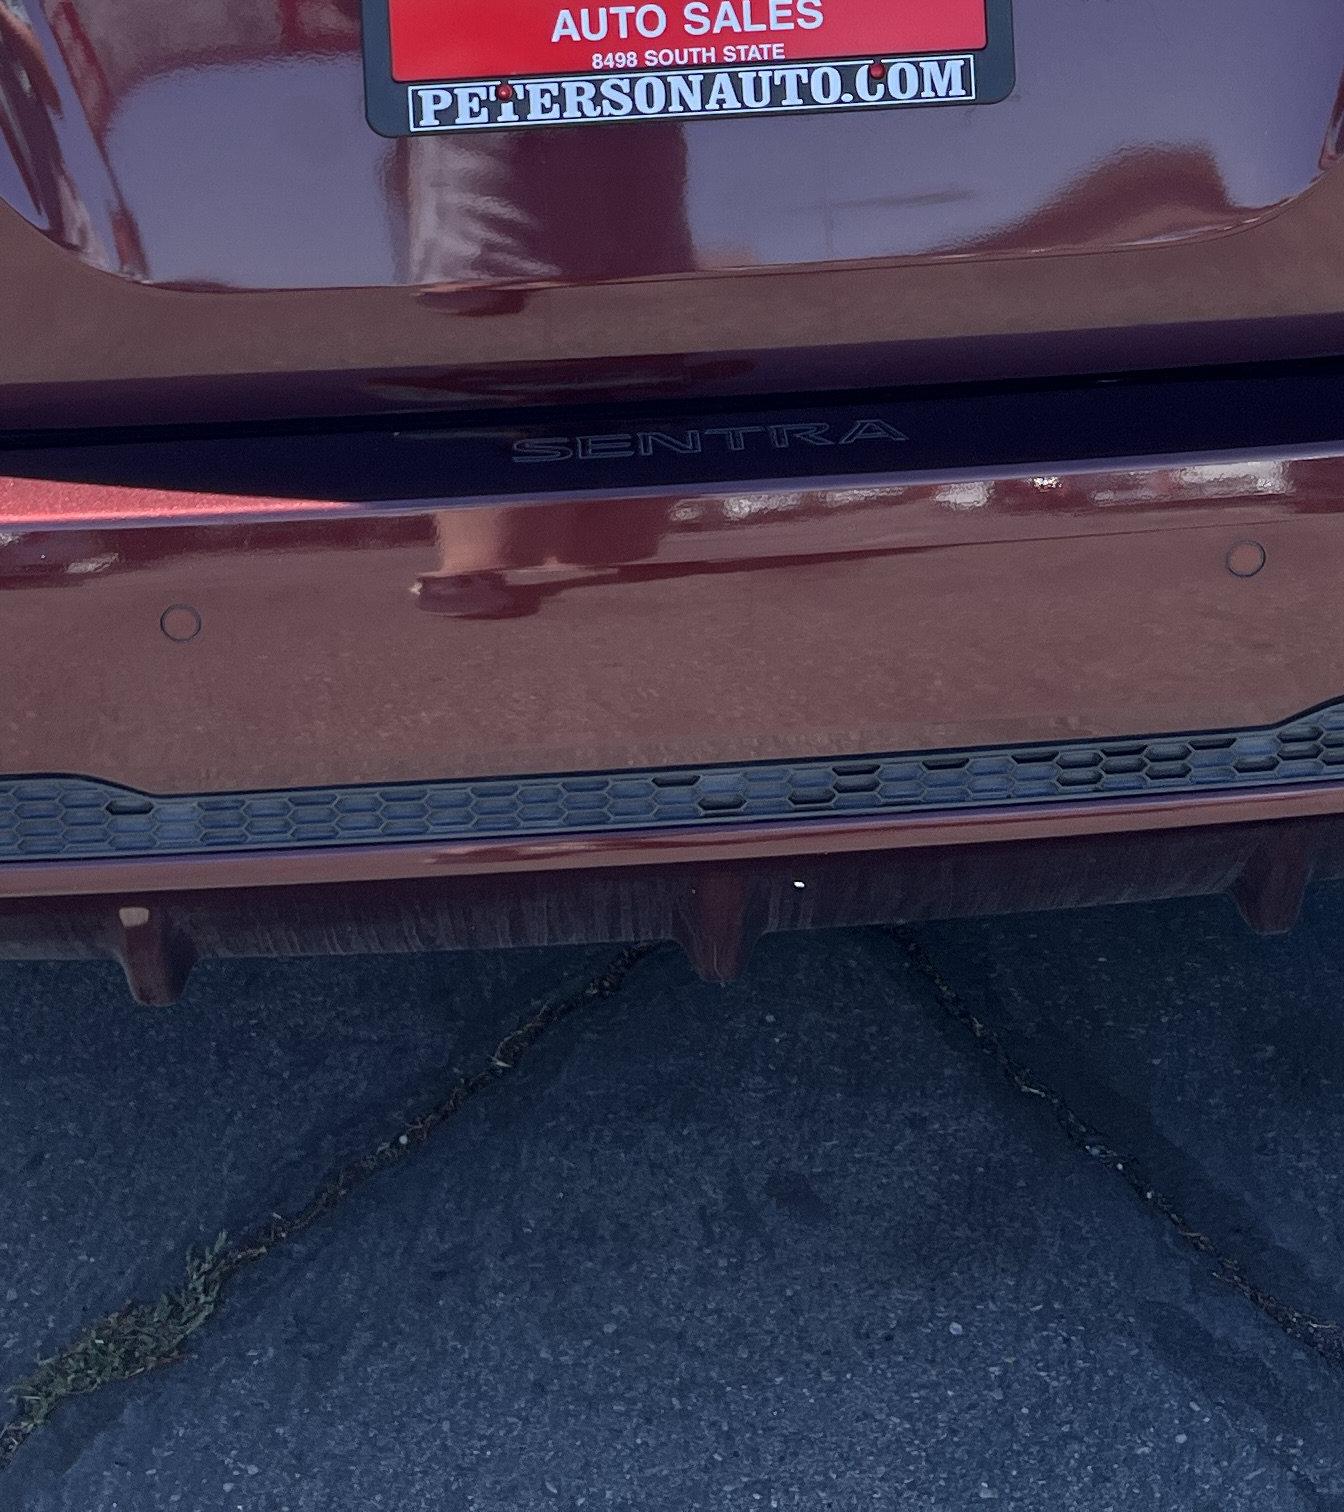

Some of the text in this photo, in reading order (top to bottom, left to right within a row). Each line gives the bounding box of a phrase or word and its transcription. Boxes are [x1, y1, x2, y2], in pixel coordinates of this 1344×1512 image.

[551, 3, 667, 43] AUTO
[591, 43, 786, 70] 8498 SOUTH STATE
[417, 59, 967, 128] PETERSONAUTO.COM
[512, 419, 909, 464] SENTRA
